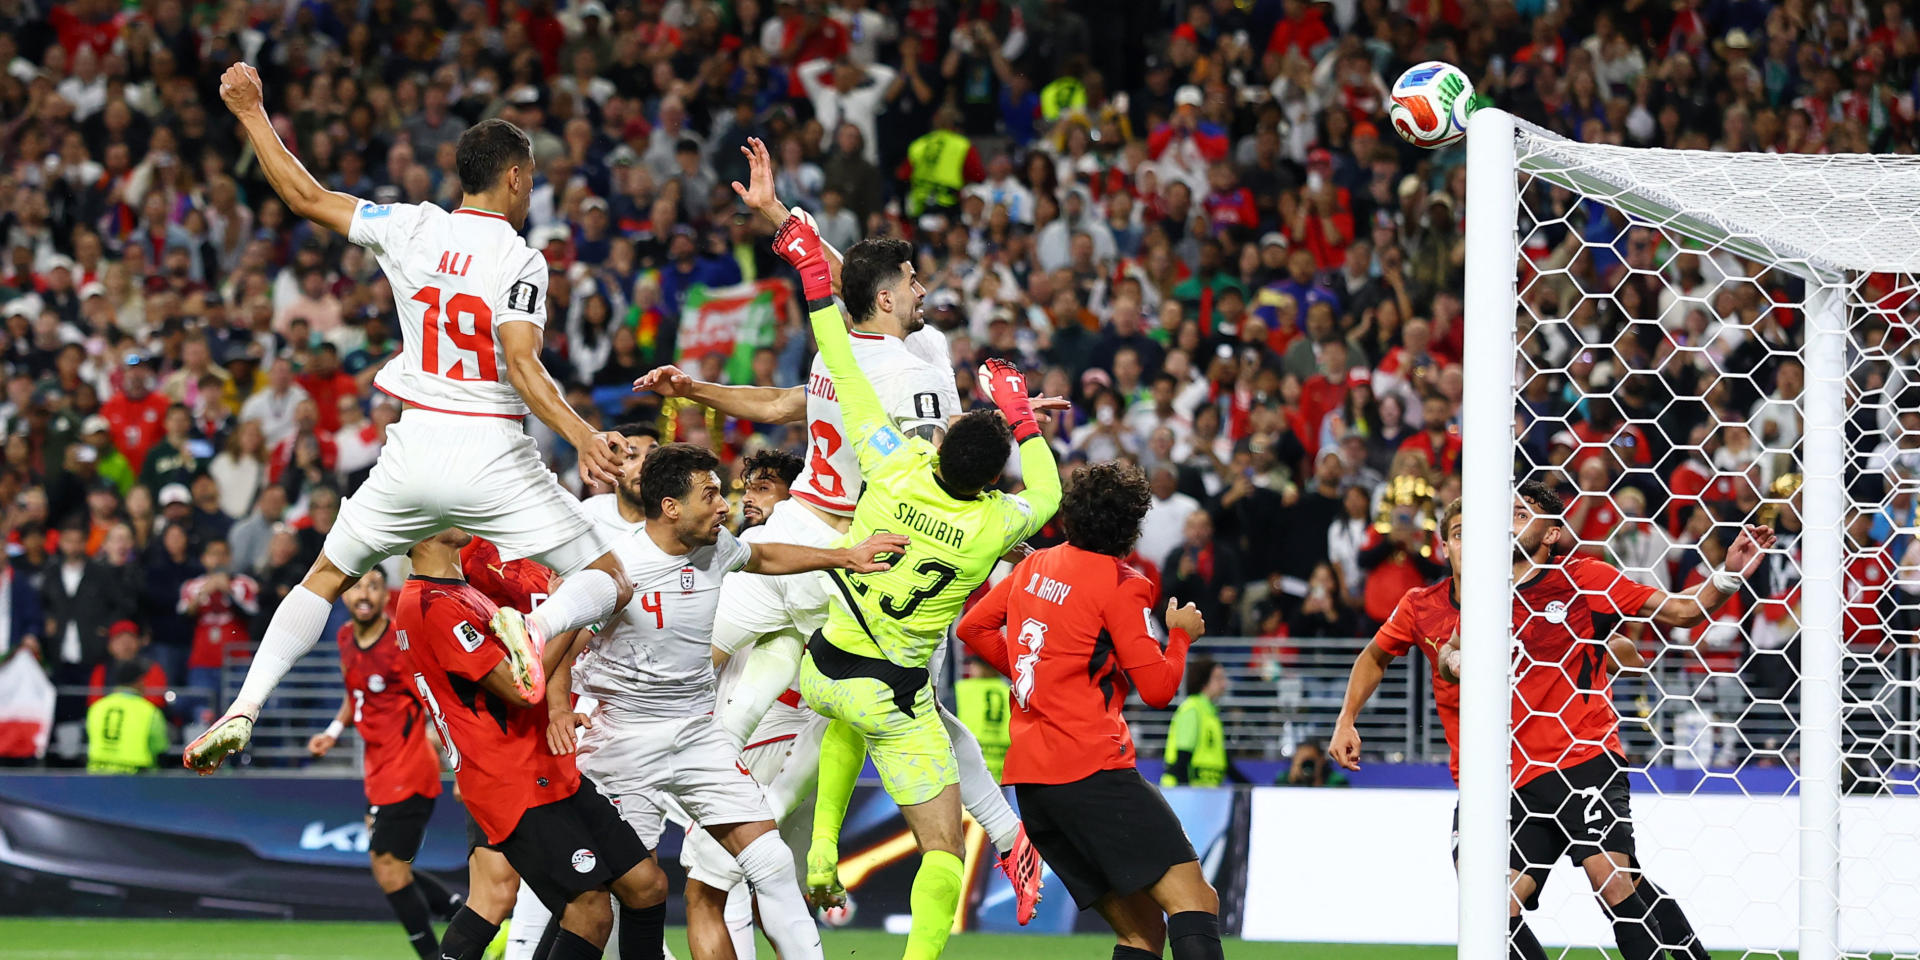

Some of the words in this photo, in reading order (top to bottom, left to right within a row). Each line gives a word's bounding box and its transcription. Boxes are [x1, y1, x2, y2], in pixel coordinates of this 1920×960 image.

[436, 251, 473, 277] ALI
[411, 286, 498, 382] 19
[894, 503, 965, 549] SHOUBIR
[641, 591, 663, 629] 4
[1036, 576, 1072, 606] HANY
[1010, 617, 1049, 713] 3
[1581, 786, 1602, 824] 2
[299, 820, 369, 852] KI
